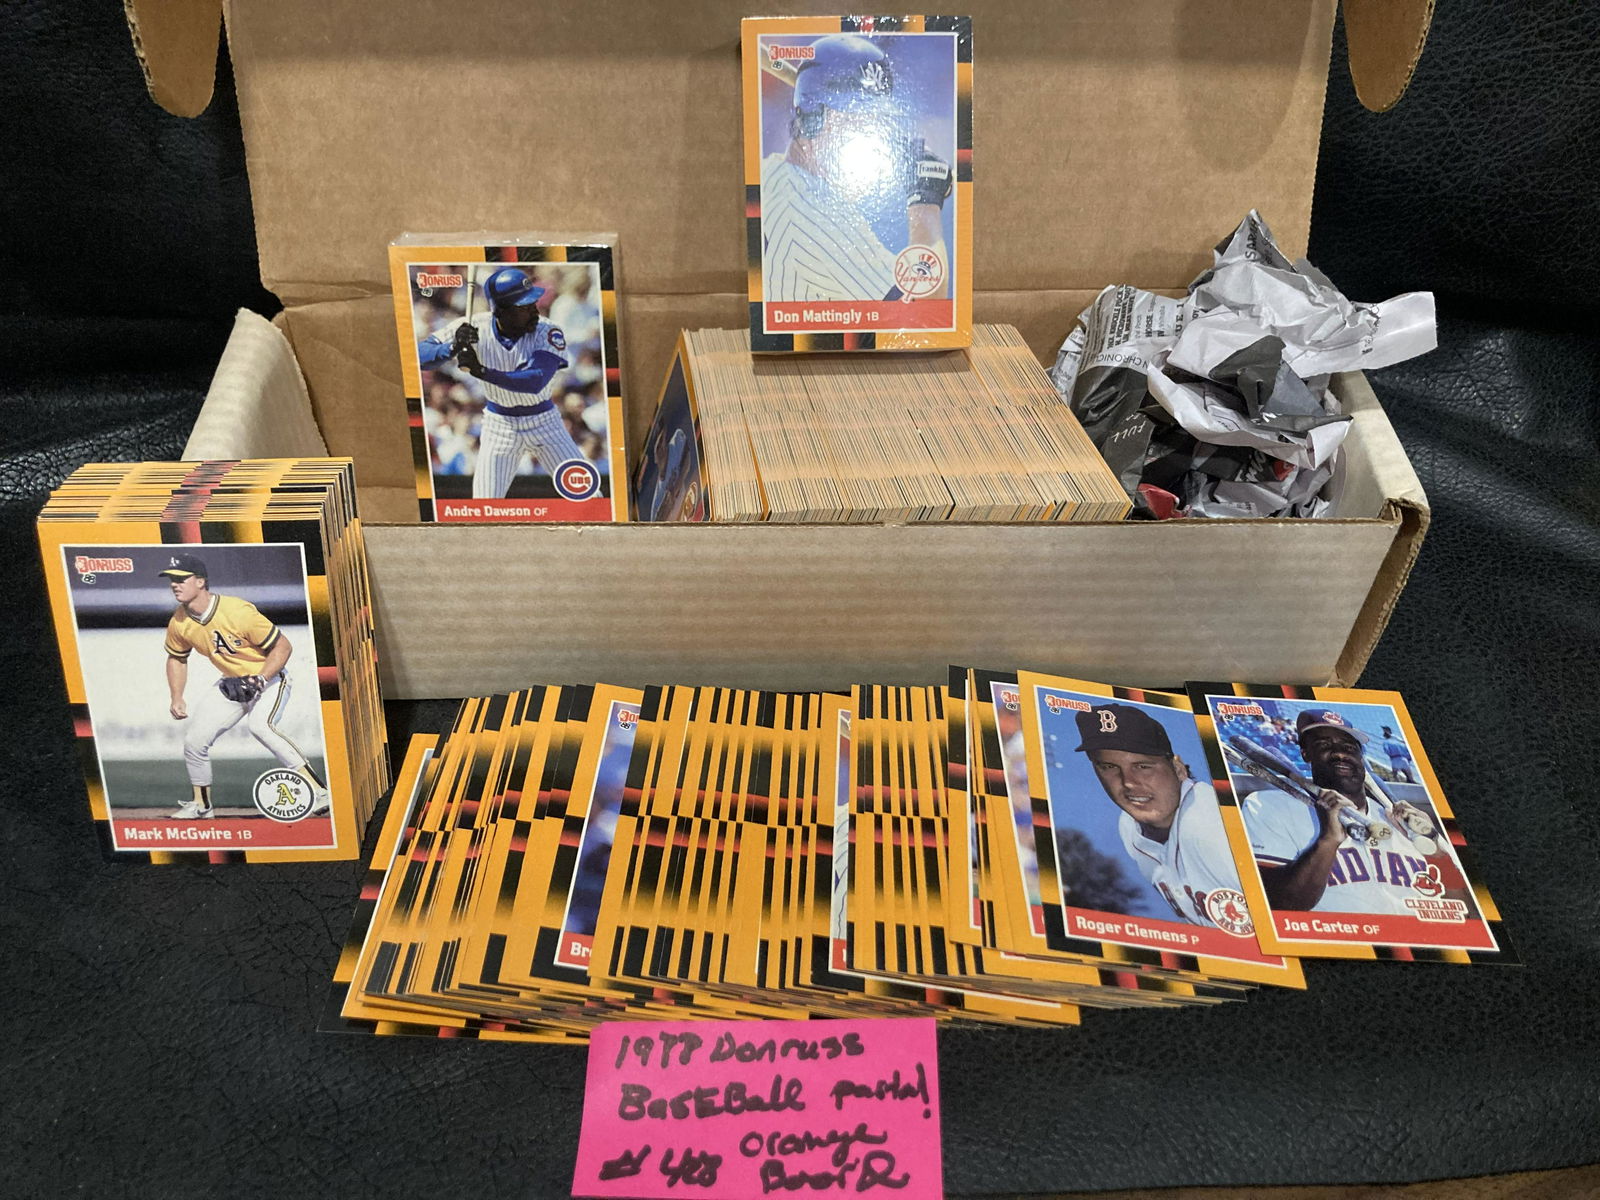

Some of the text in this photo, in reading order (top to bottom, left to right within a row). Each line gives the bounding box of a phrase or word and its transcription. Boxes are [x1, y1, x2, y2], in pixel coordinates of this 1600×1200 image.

[418, 273, 463, 287] DONRUSS
[773, 309, 879, 325] Don Mattingly 1B
[444, 505, 548, 517] Andre Dawson OF
[76, 556, 133, 573] DONRUSS
[1046, 695, 1091, 712] DONRUSS
[1218, 703, 1264, 715] DONRUSS
[1097, 709, 1119, 732] B
[264, 772, 302, 786] OAKLAND
[266, 803, 307, 817] ATHLETICS
[124, 827, 252, 840] Mark McGwire 1B
[1328, 847, 1427, 887] NDIAN
[1211, 890, 1248, 908] BOSTO
[1404, 899, 1465, 911] CLEVELAND
[1418, 910, 1463, 921] INDIANS
[1075, 915, 1200, 944] Roger Clemens P
[1284, 918, 1380, 935] Joe Carter OF
